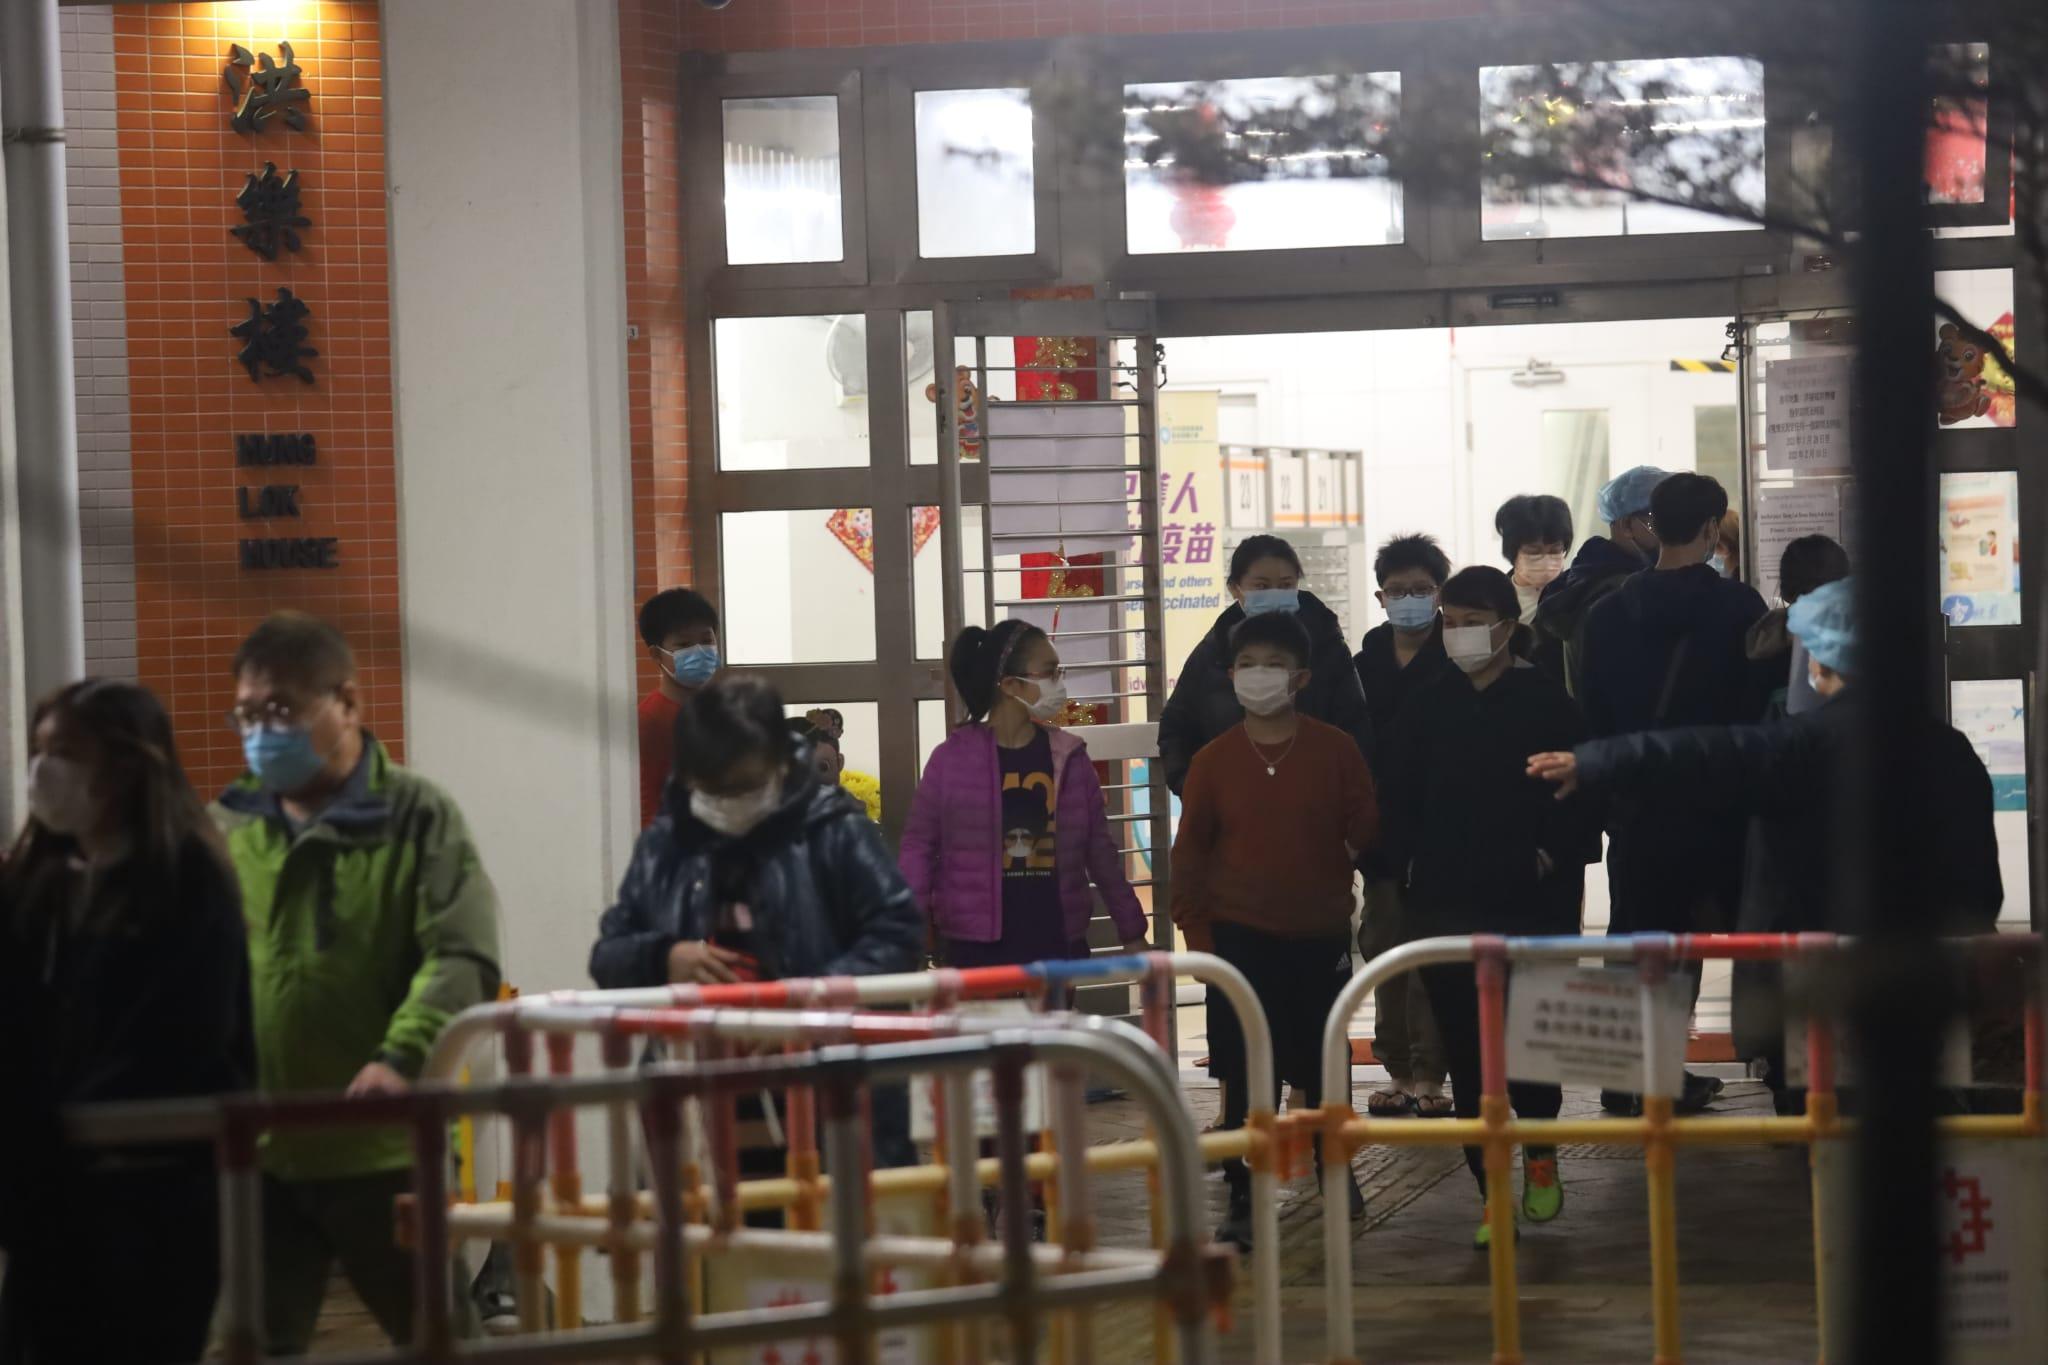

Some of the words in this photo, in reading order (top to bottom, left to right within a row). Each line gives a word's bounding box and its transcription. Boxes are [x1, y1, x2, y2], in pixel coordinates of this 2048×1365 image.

[224, 40, 319, 385] 洪樂樓
[237, 433, 316, 466] HUNG
[238, 485, 300, 518] LOK
[239, 537, 340, 569] HOUSE
[1179, 575, 1213, 590] others
[1161, 593, 1221, 612] ccinated
